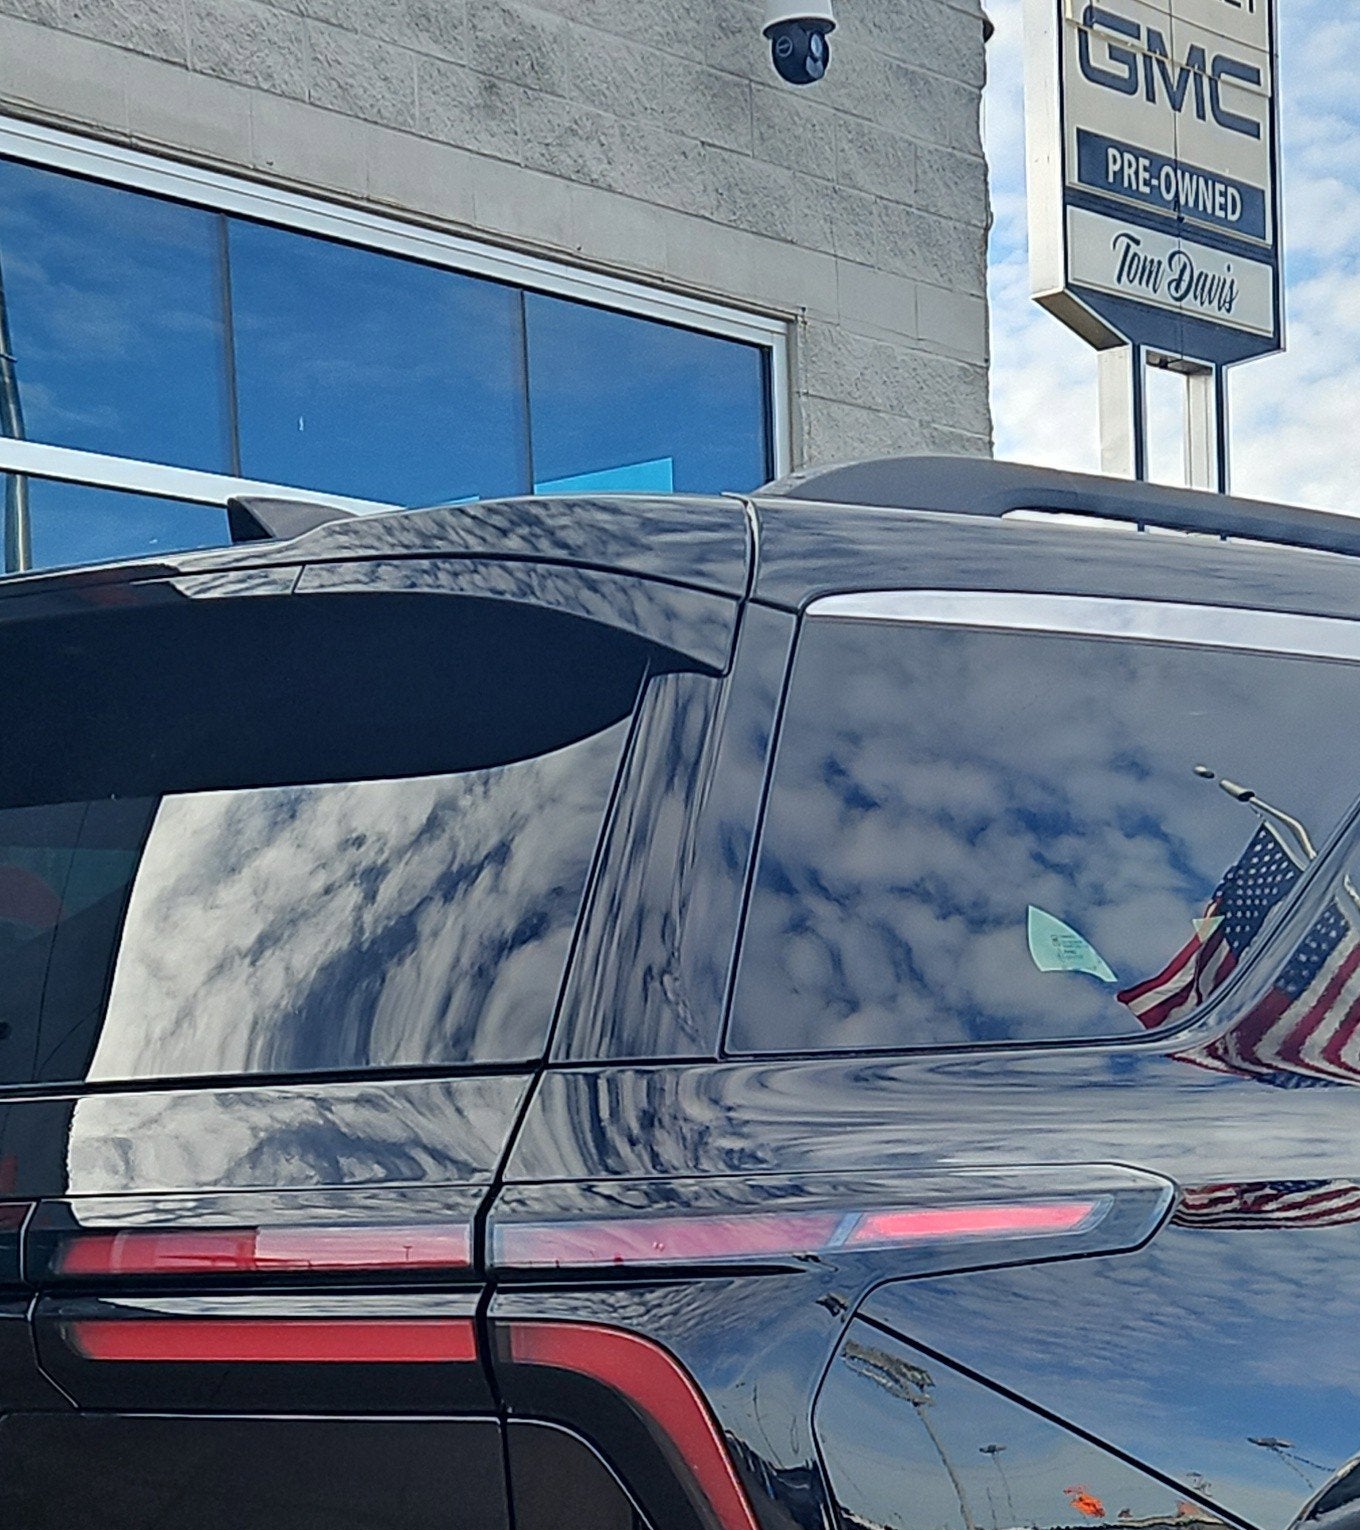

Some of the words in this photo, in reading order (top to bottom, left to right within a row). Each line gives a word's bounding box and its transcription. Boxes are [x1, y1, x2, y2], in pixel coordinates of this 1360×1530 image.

[1076, 4, 1262, 140] GMC
[1106, 148, 1242, 222] PRE-OWNED
[1112, 232, 1164, 293] Tom
[1167, 250, 1239, 314] Davis
